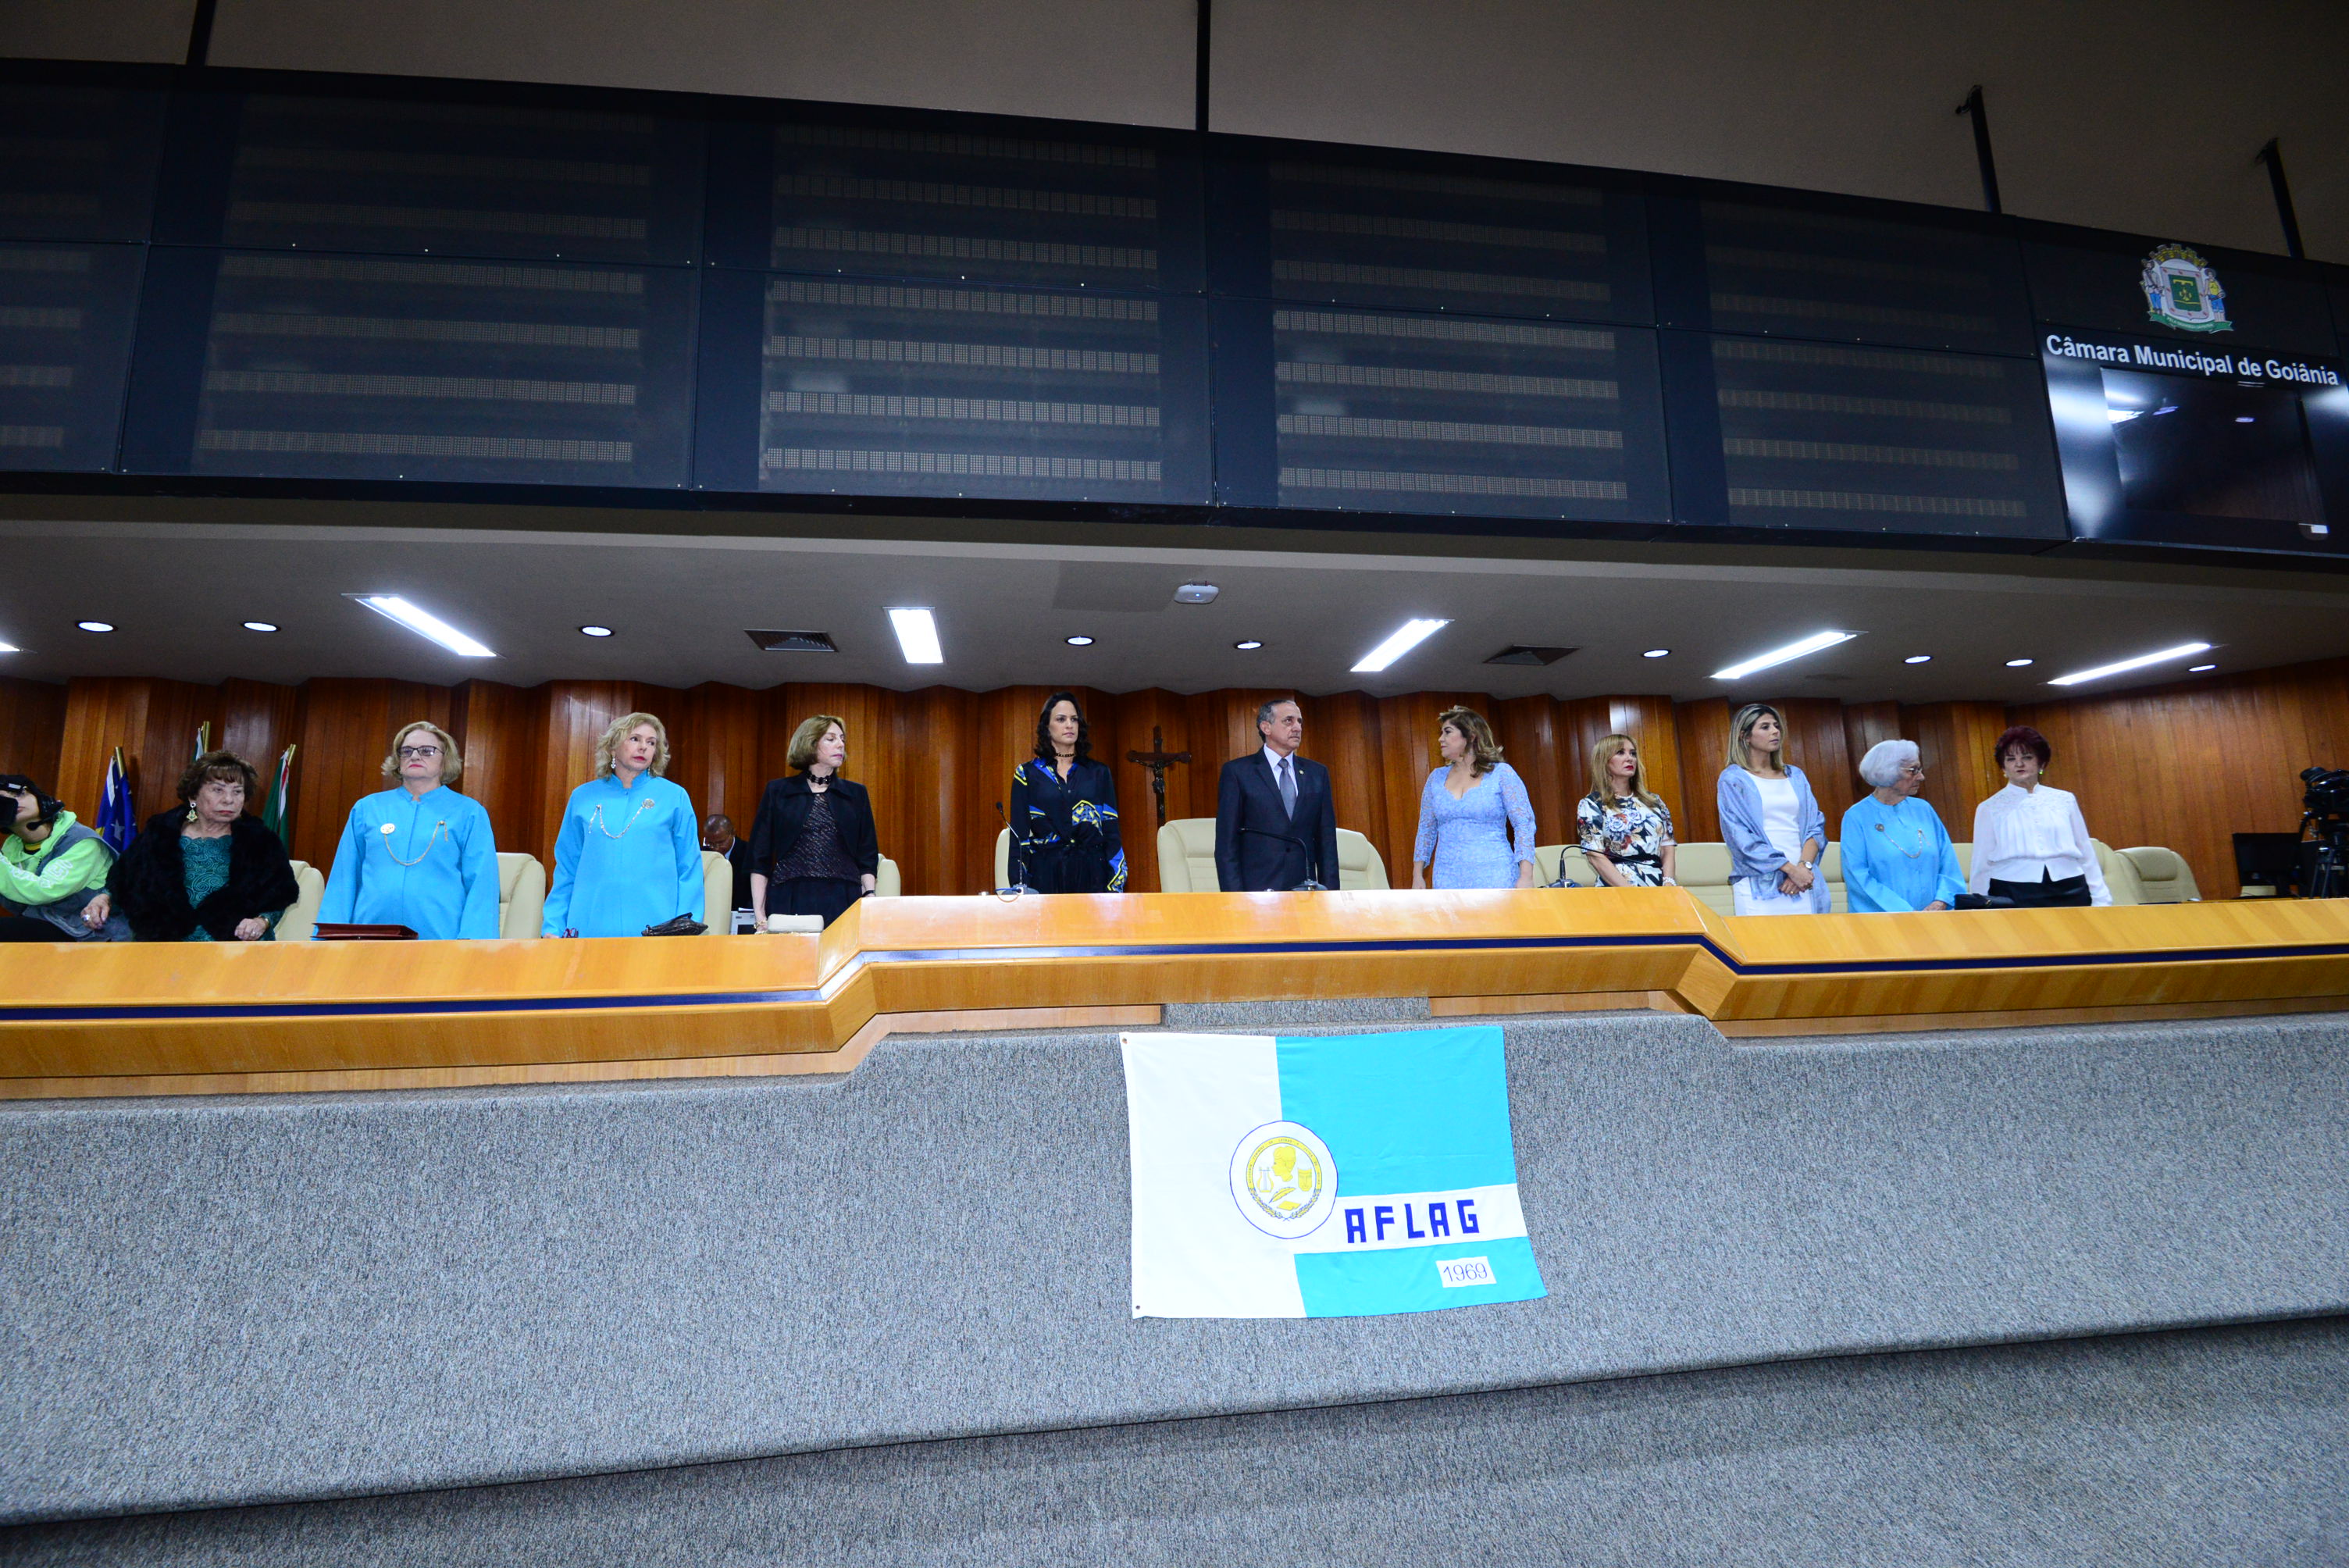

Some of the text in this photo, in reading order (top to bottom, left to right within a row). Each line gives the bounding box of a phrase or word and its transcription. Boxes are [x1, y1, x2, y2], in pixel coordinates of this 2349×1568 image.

[2046, 334, 2340, 386] Câmara Municipal de Goiânia
[1344, 1199, 1480, 1244] AFLAG
[1443, 1262, 1488, 1283] 1969
